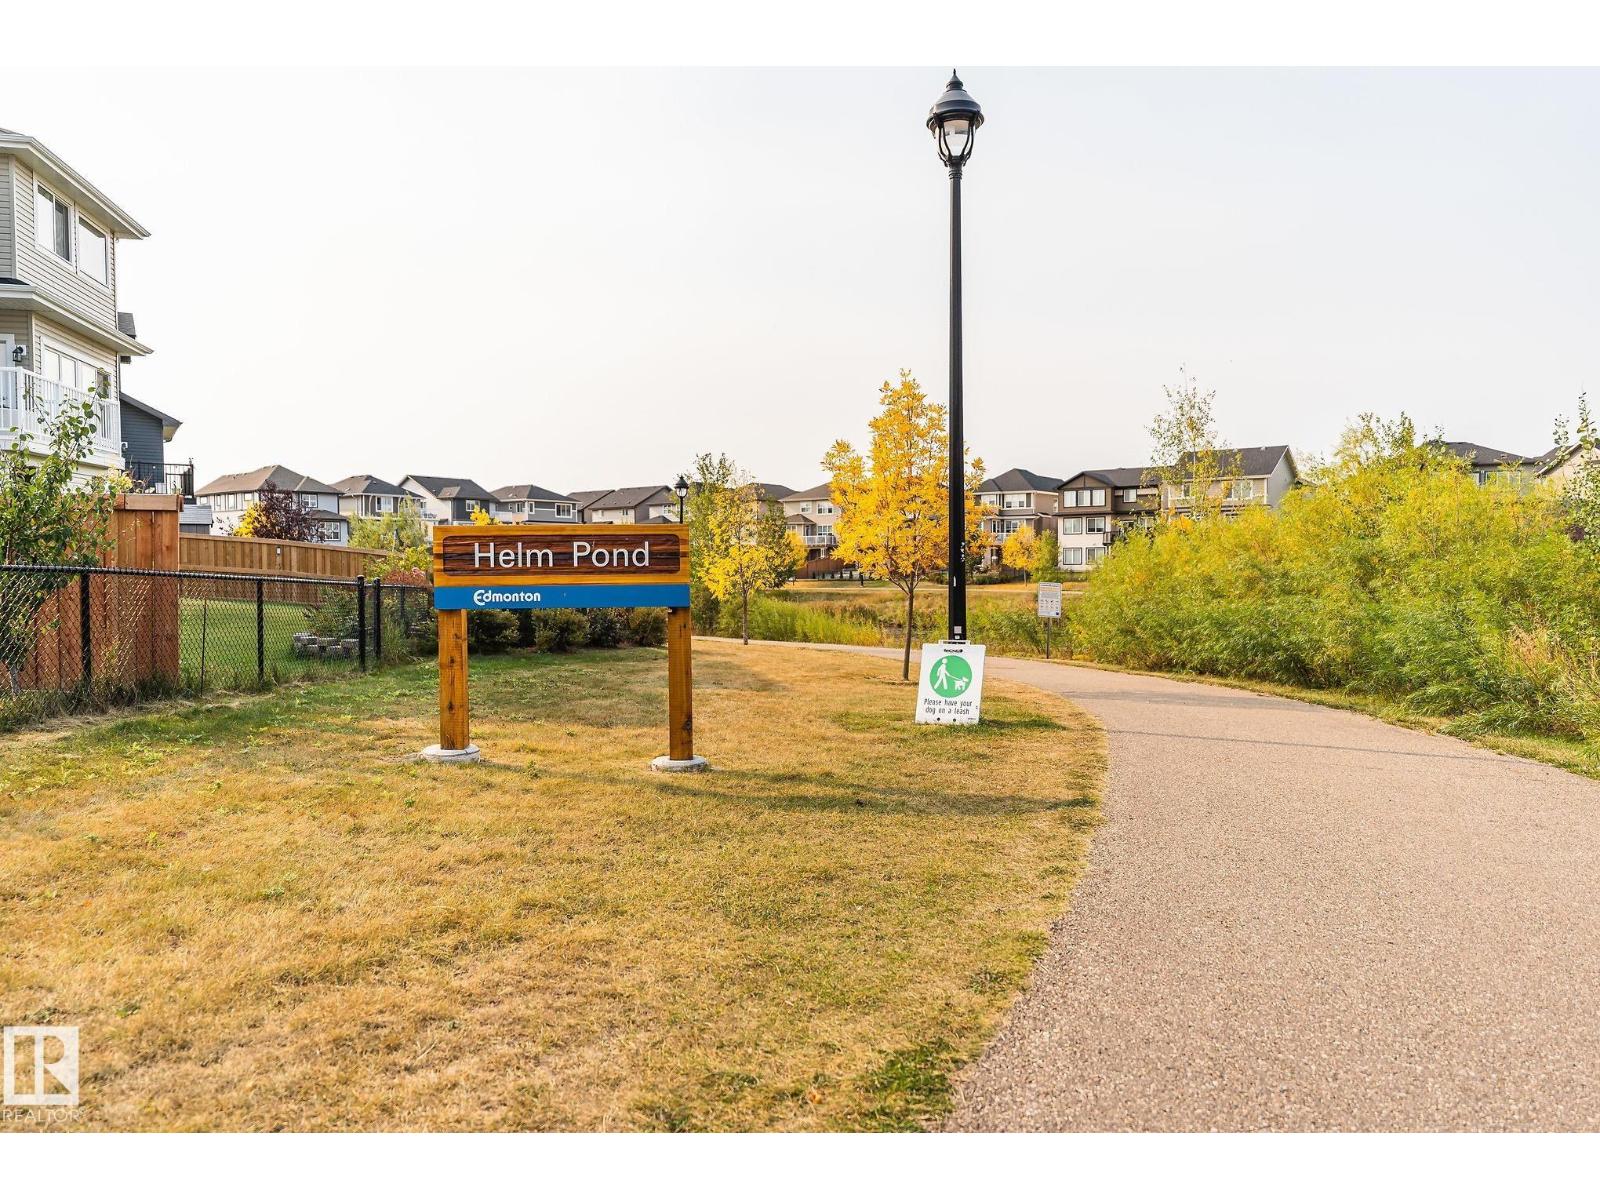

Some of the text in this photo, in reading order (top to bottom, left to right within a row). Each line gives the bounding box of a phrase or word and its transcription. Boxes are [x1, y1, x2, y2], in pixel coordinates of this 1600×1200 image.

[474, 541, 649, 568] Helm Pond
[473, 589, 541, 606] Edmonton
[923, 698, 942, 706] Please
[925, 707, 936, 715] dog
[954, 707, 970, 715] leash
